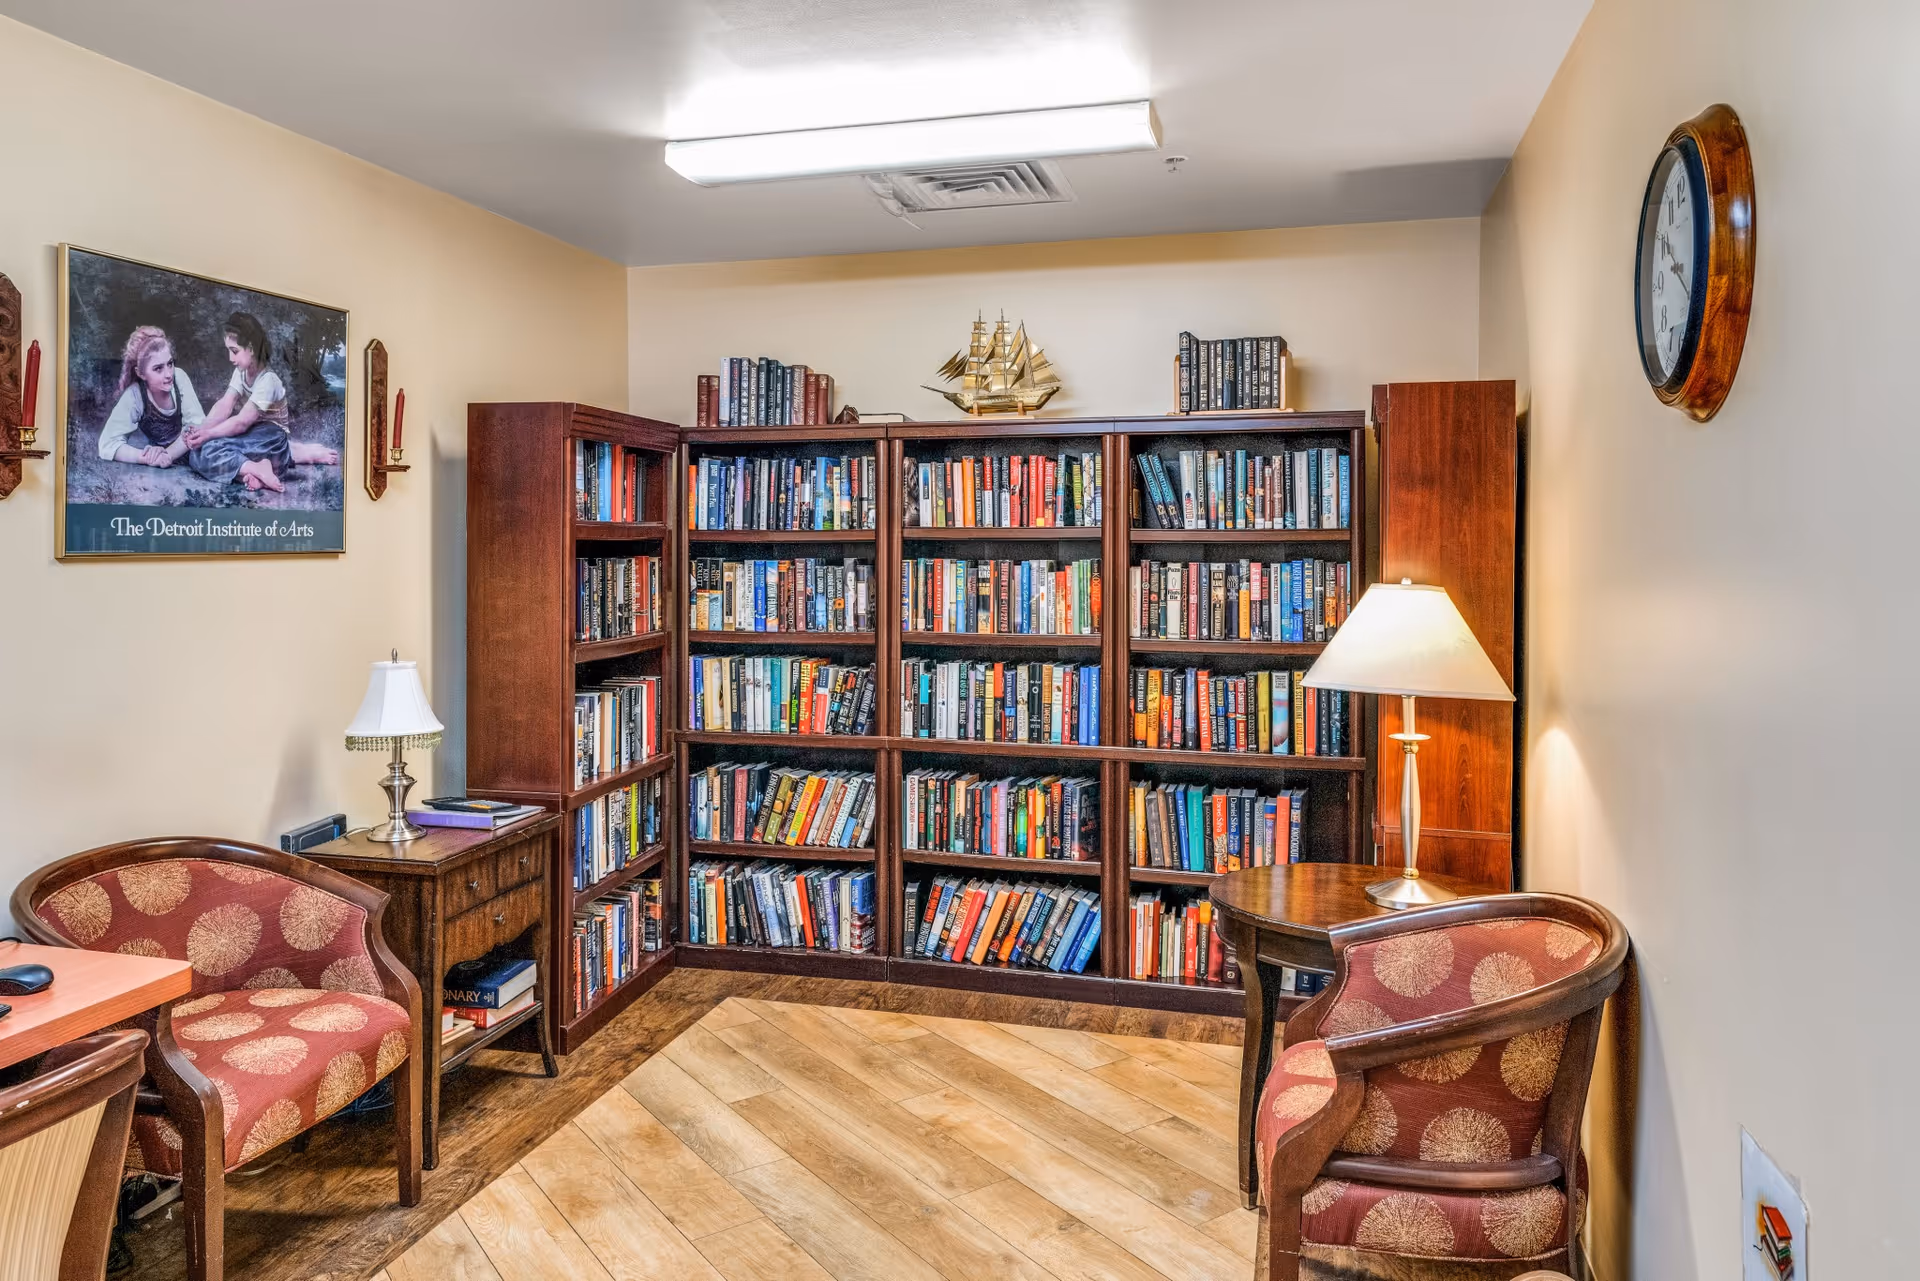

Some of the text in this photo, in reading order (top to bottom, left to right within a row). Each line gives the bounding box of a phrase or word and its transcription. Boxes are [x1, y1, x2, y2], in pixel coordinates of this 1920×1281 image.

[1677, 175, 1686, 209] 12
[1657, 270, 1664, 297] 9
[1661, 305, 1667, 333] 8
[1140, 454, 1163, 502] JAMES PATTERSON
[1152, 455, 1173, 502] JAMES PATTERSON
[111, 517, 314, 537] The Detroit Institute of Arts
[1092, 572, 1100, 602] KOONTZ
[1305, 578, 1313, 599] ROBB
[1216, 817, 1225, 833] Silva
[1230, 797, 1240, 833] Daniel Silva
[1290, 827, 1299, 857] KNOCKOUT
